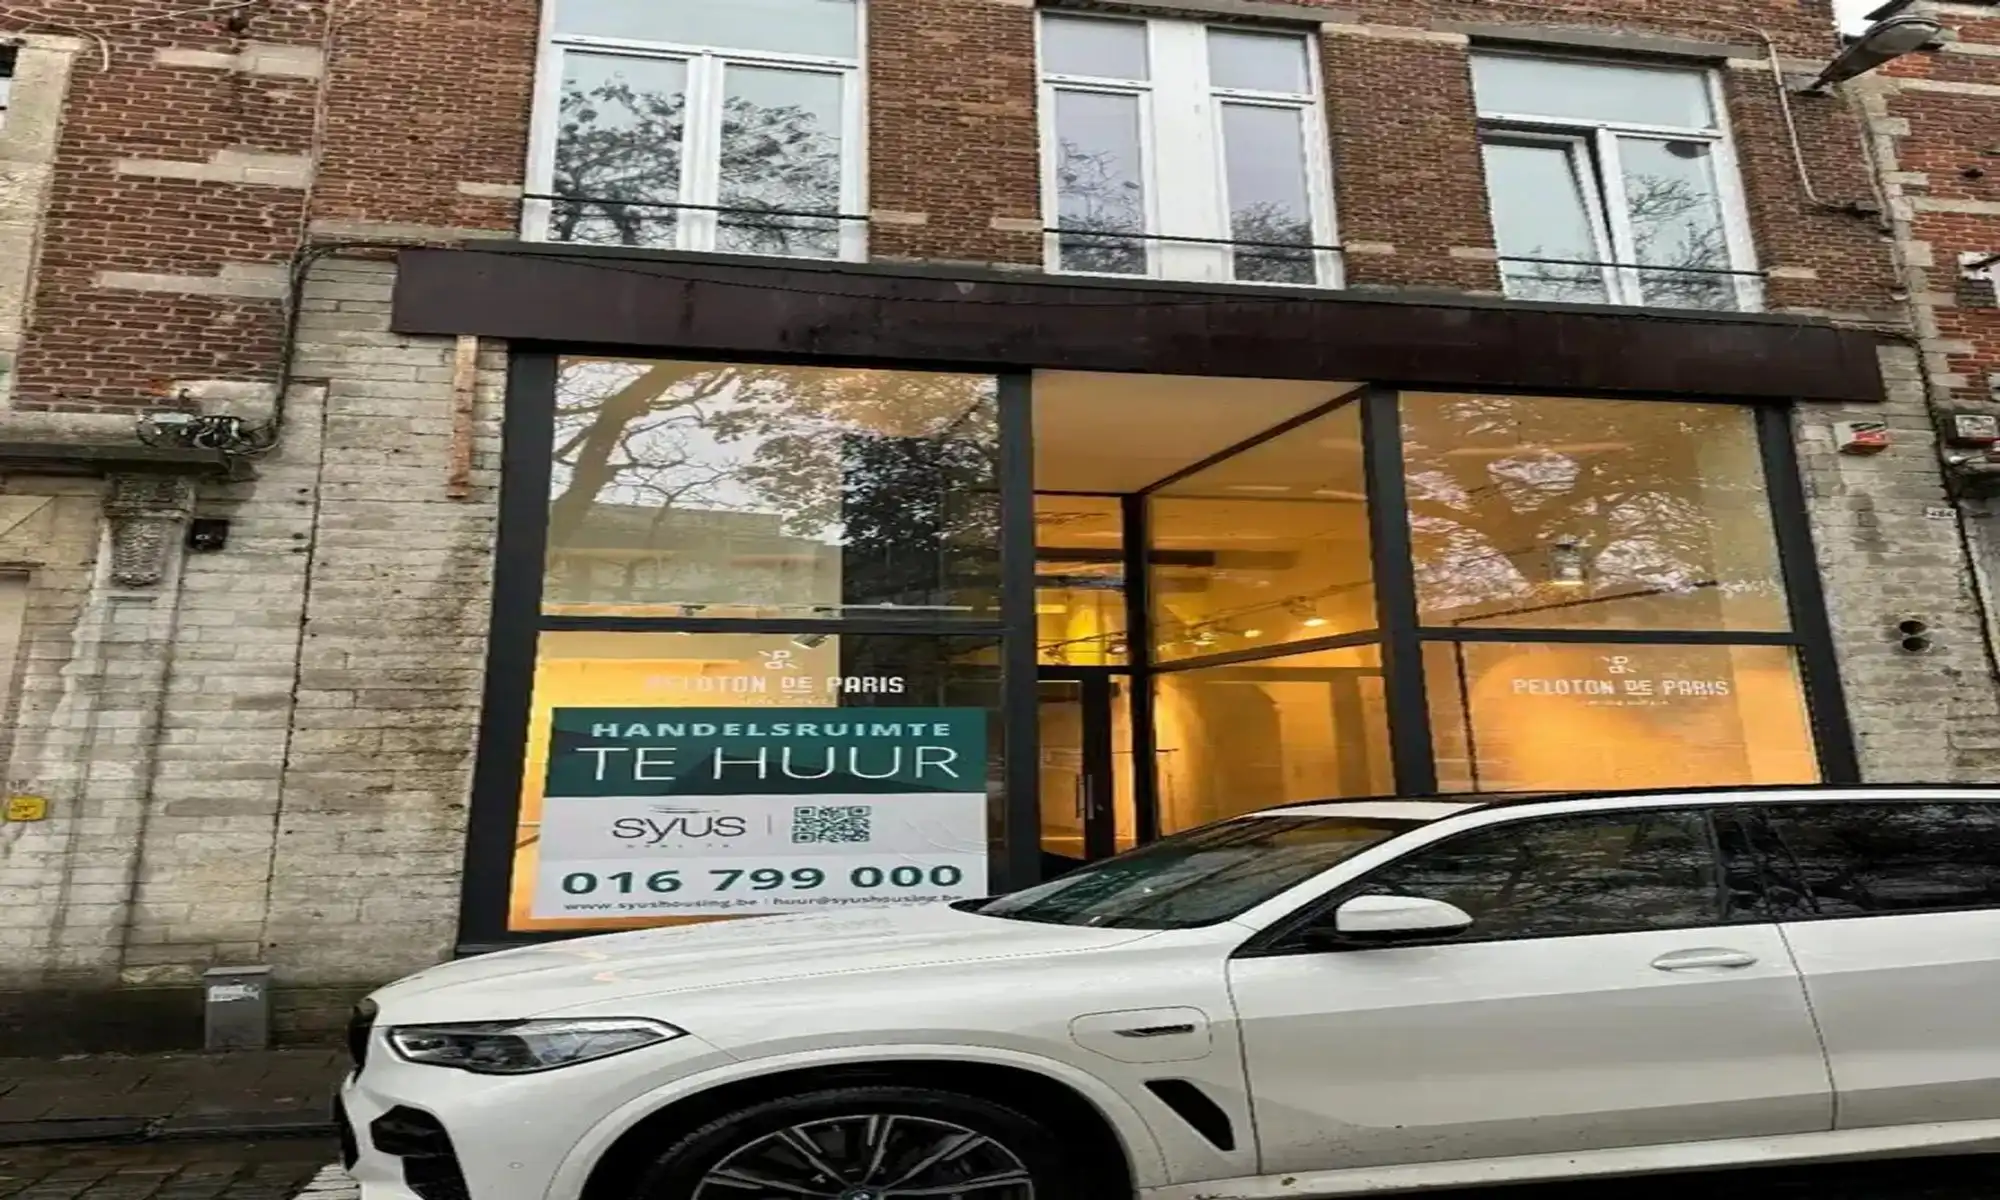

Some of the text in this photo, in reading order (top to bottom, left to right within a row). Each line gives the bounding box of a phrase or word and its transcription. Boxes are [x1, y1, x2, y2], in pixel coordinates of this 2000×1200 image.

[644, 675, 904, 693] LOTON DE PARIS
[1512, 679, 1729, 696] PELOTON DE PARIS
[592, 722, 952, 738] HANDELSRUIMTE
[575, 745, 960, 782] TE HUUR
[563, 864, 964, 895] 016 799 000
[564, 897, 758, 911] www.syushousing.be
